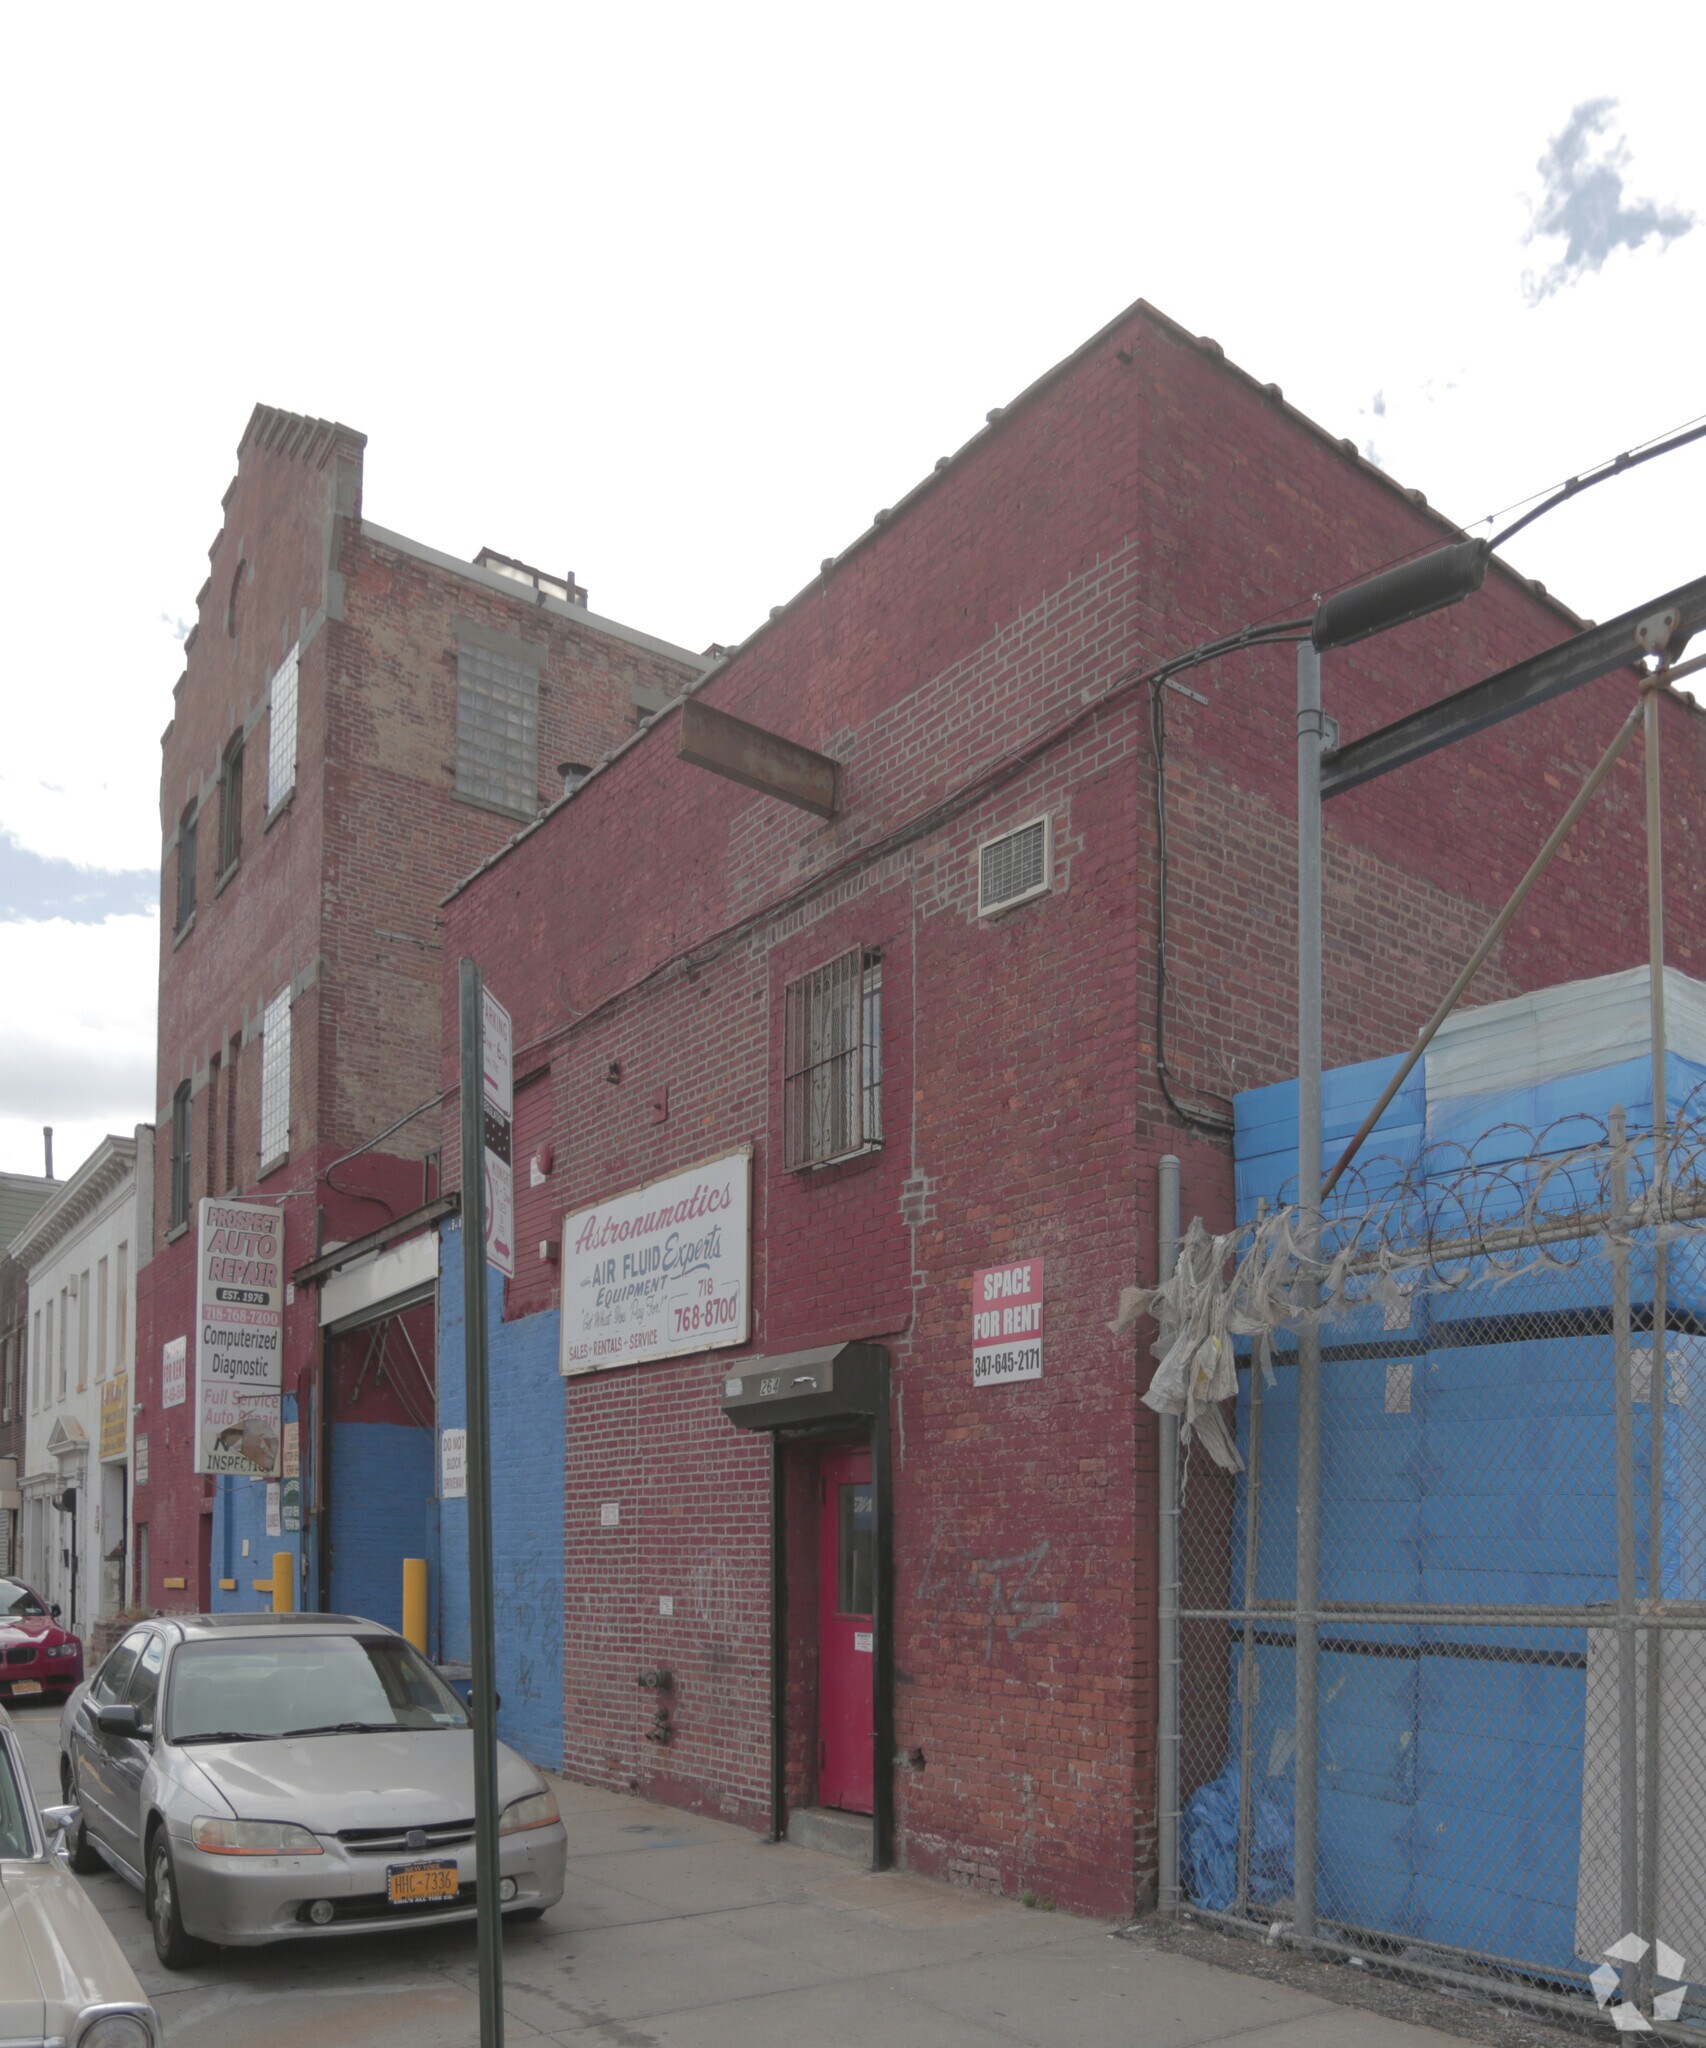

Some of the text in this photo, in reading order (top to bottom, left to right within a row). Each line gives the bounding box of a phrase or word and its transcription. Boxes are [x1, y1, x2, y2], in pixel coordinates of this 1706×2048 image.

[483, 1003, 508, 1042] ARKING
[207, 1206, 280, 1234] PROSPECT
[575, 1182, 732, 1254] Astronumatics
[207, 1229, 277, 1259] AUTO
[591, 1224, 722, 1287] AIR FLUID Experts
[209, 1256, 278, 1288] REPAIR
[983, 1265, 1031, 1301] SPACE
[222, 1290, 264, 1303] EST. 1976
[596, 1274, 668, 1309] EQUIPMENT
[698, 1277, 713, 1297] 718
[205, 1306, 278, 1325] 718-768-7200
[674, 1295, 738, 1333] 768-8700
[974, 1302, 1042, 1340] FOR RENT
[203, 1324, 278, 1351] Computerized
[569, 1329, 658, 1361] SALES RENTALS SERVICE
[212, 1353, 268, 1379] Diagnostic
[975, 1348, 1040, 1377] 347-645-2171
[204, 1389, 228, 1404] Full
[232, 1390, 279, 1408] Service
[761, 1378, 780, 1395] 264
[205, 1408, 234, 1425] Auto
